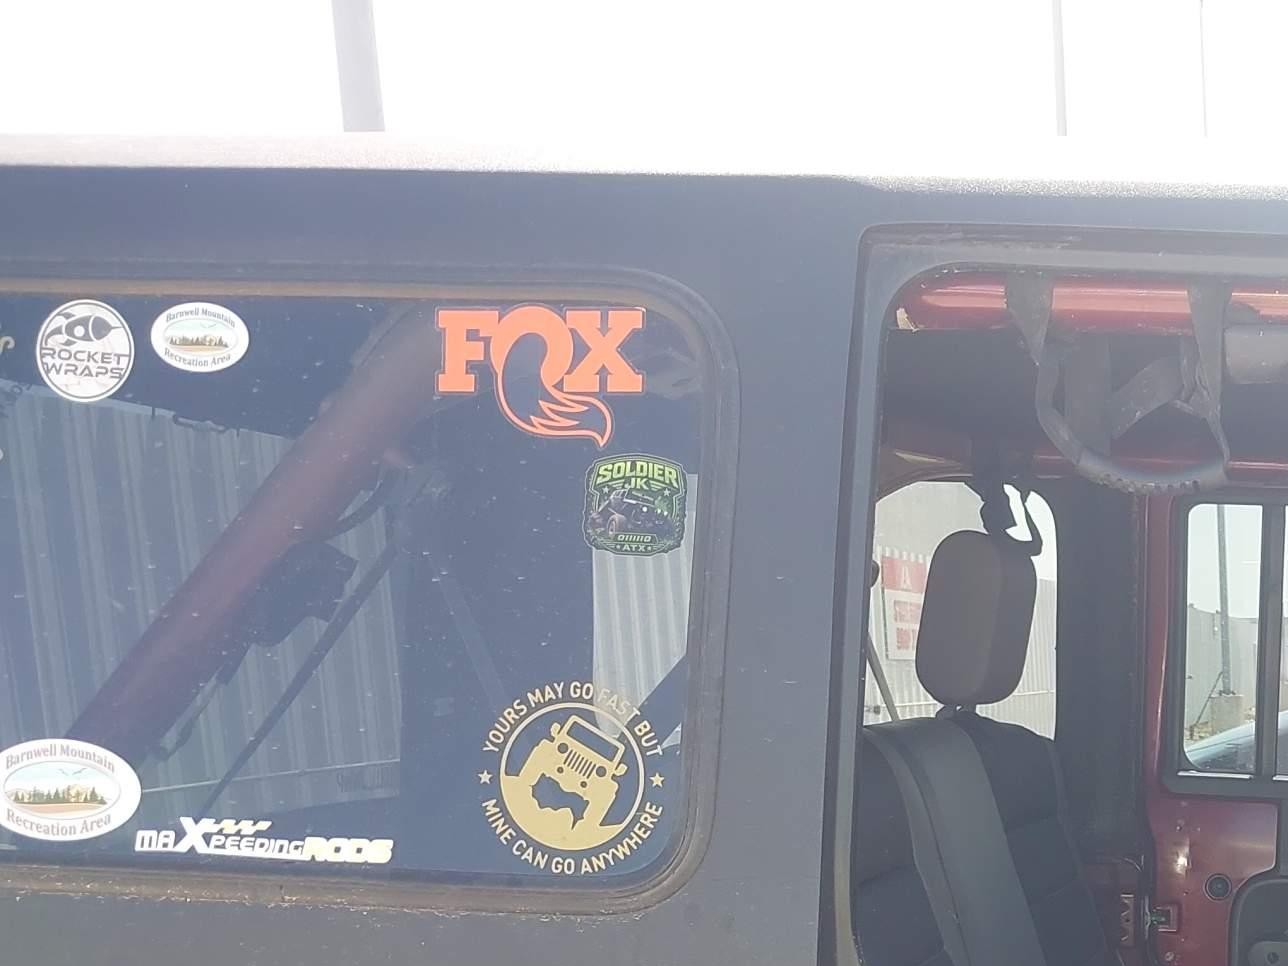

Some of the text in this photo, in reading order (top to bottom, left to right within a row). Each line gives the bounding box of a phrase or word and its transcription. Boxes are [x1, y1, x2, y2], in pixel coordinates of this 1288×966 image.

[166, 307, 236, 328] Barnwell Mountain
[40, 347, 130, 366] ROCKET
[164, 347, 231, 368] Recreation Area
[43, 362, 124, 379] WRAPS
[438, 305, 643, 447] FOX
[596, 461, 679, 489] SOLDIER
[624, 477, 649, 490] JK
[622, 544, 647, 552] ATX
[483, 681, 663, 756] YOURS MAY GO FAST BUT
[6, 744, 115, 773] Barnwell Mountain
[7, 808, 112, 836] Recreation Area
[482, 799, 663, 875] MINE CAN GO ANYWHERE
